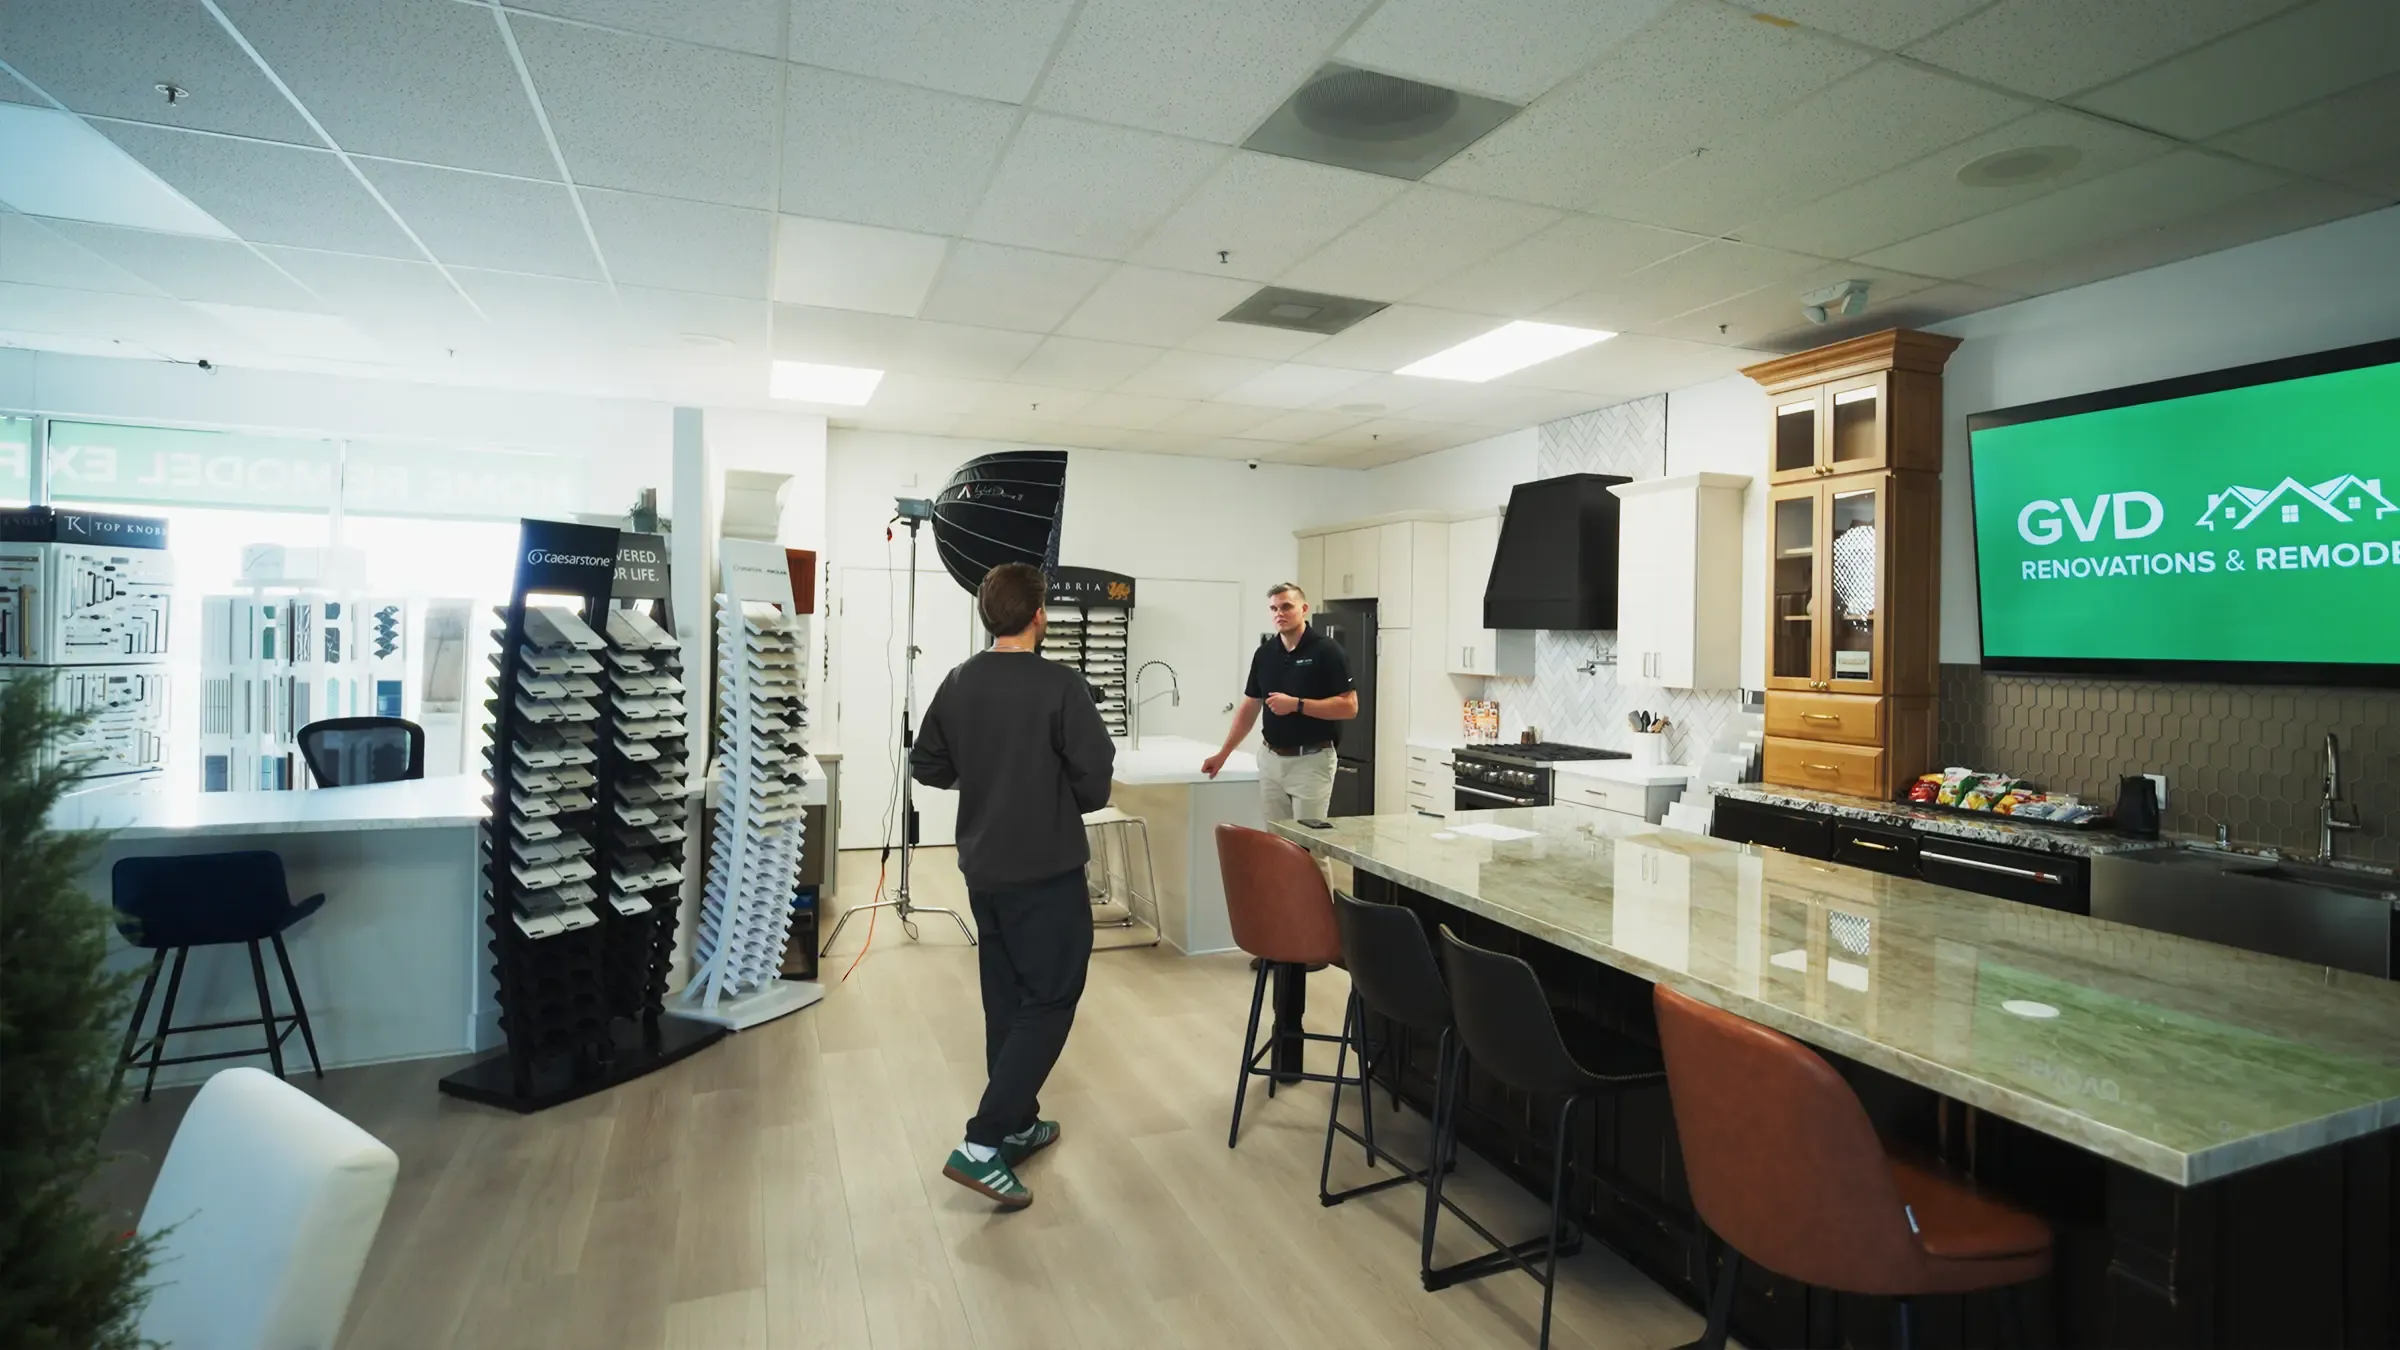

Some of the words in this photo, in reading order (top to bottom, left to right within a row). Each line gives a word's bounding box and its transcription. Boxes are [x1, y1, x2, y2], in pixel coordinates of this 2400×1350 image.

[2017, 490, 2164, 546] GVD
[95, 522, 120, 532] TOP
[127, 525, 166, 536] KNOBS
[544, 553, 611, 567] caesarstone
[2021, 550, 2216, 580] RENOVATIONS
[2225, 548, 2246, 571] &
[631, 568, 660, 582] LIFE.
